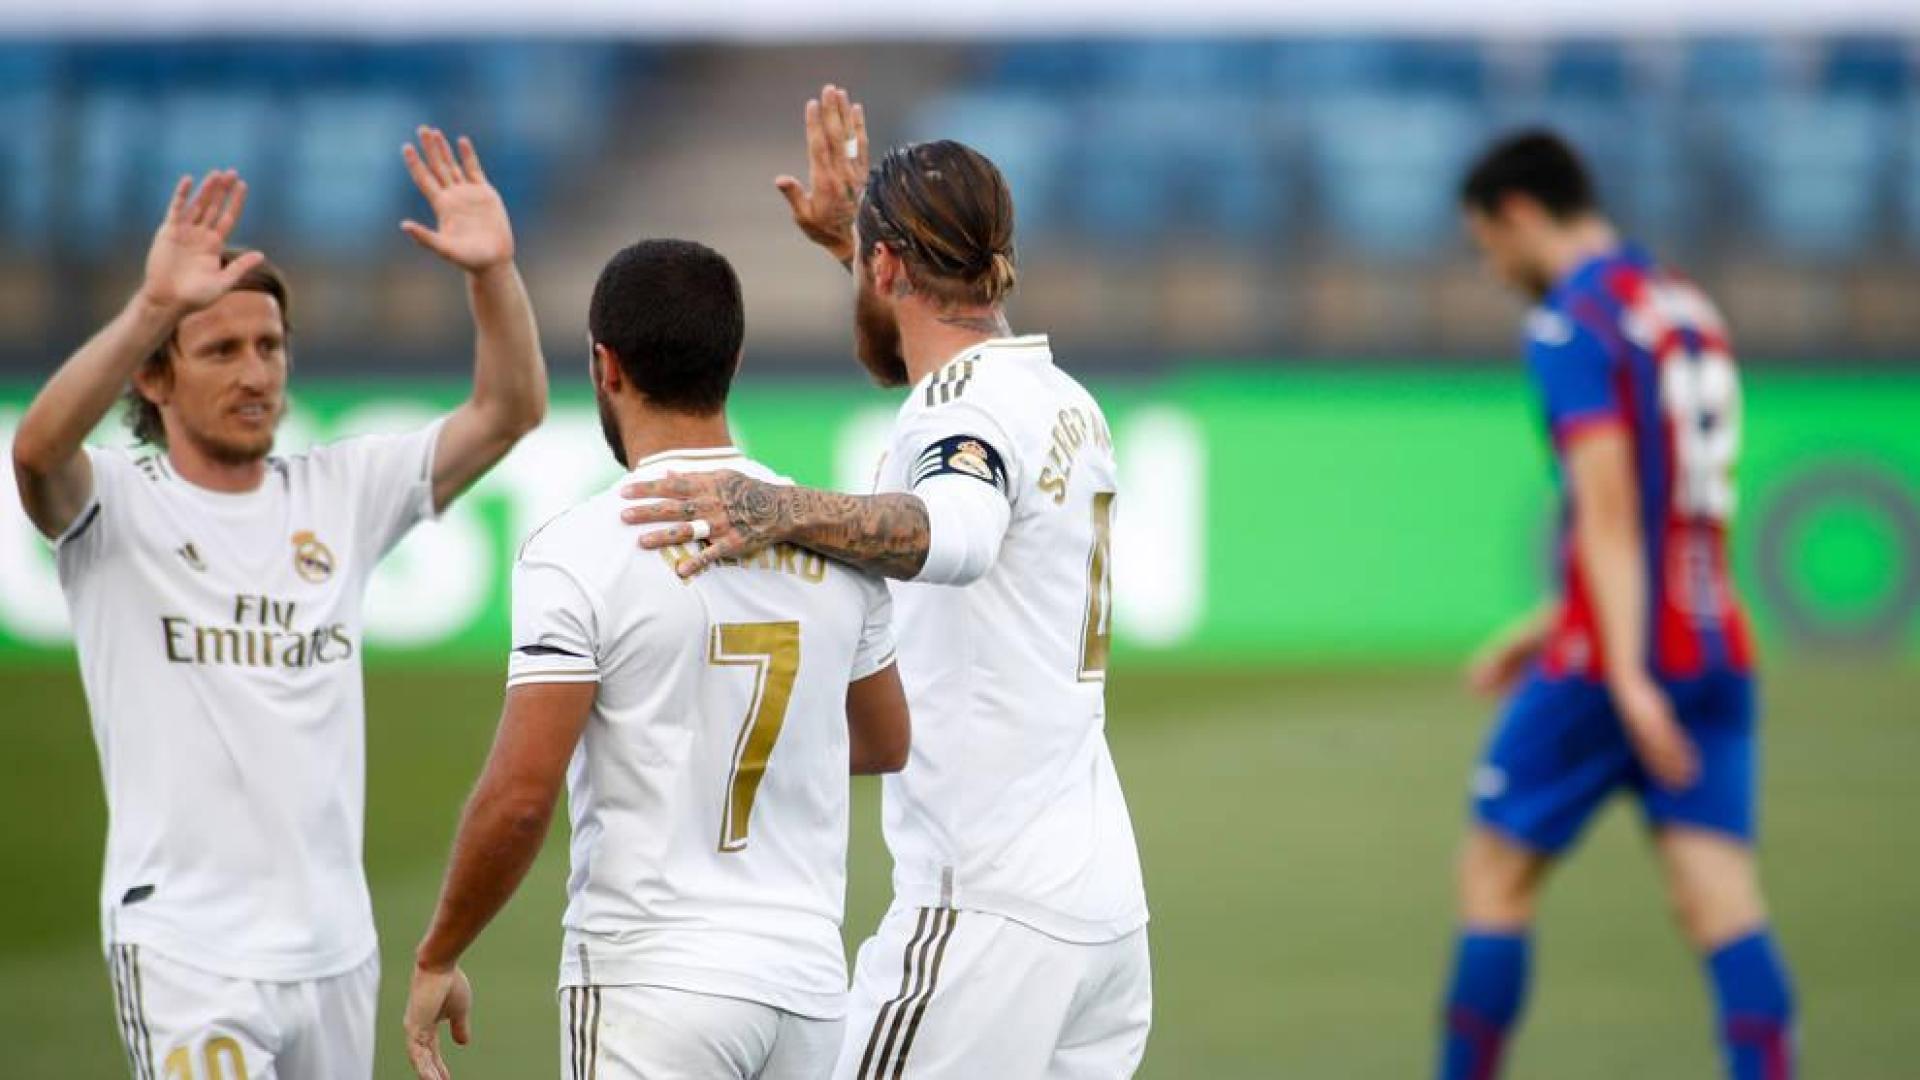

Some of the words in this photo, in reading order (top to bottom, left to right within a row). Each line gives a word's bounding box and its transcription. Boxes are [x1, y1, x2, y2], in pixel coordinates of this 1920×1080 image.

[234, 593, 296, 631] Fly
[161, 615, 354, 669] Emirates
[708, 619, 800, 853] 7
